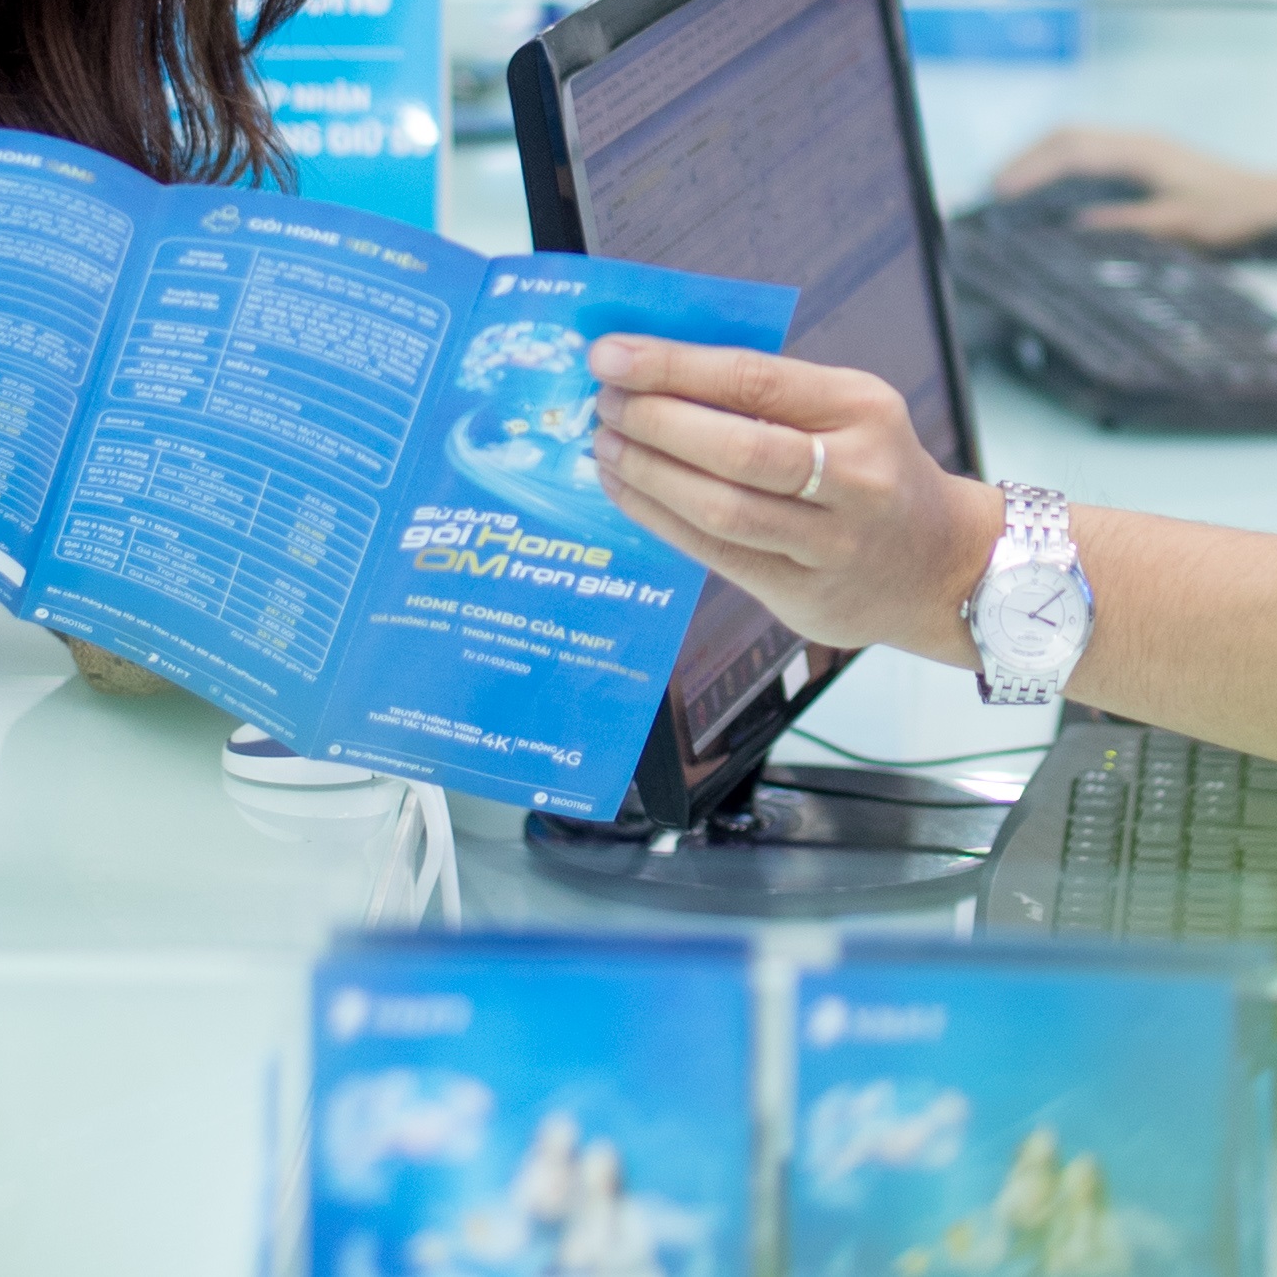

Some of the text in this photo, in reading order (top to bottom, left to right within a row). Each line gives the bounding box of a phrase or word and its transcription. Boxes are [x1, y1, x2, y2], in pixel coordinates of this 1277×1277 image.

[284, 223, 341, 247] HOME
[521, 279, 586, 296] VNPT
[413, 506, 453, 521] Sử
[400, 522, 613, 568] gói Home
[510, 560, 575, 589] trọn
[576, 575, 637, 600] giải
[638, 584, 675, 608] trí
[406, 594, 616, 651] HOME COMBO CỦA VNPT
[161, 659, 191, 678] VNPT
[476, 653, 531, 674] 01/03/2020
[454, 722, 483, 736] VIDEO
[454, 731, 479, 744] MINH
[482, 732, 511, 752] 4K
[551, 749, 583, 766] 4G
[550, 796, 593, 812] 18001166
